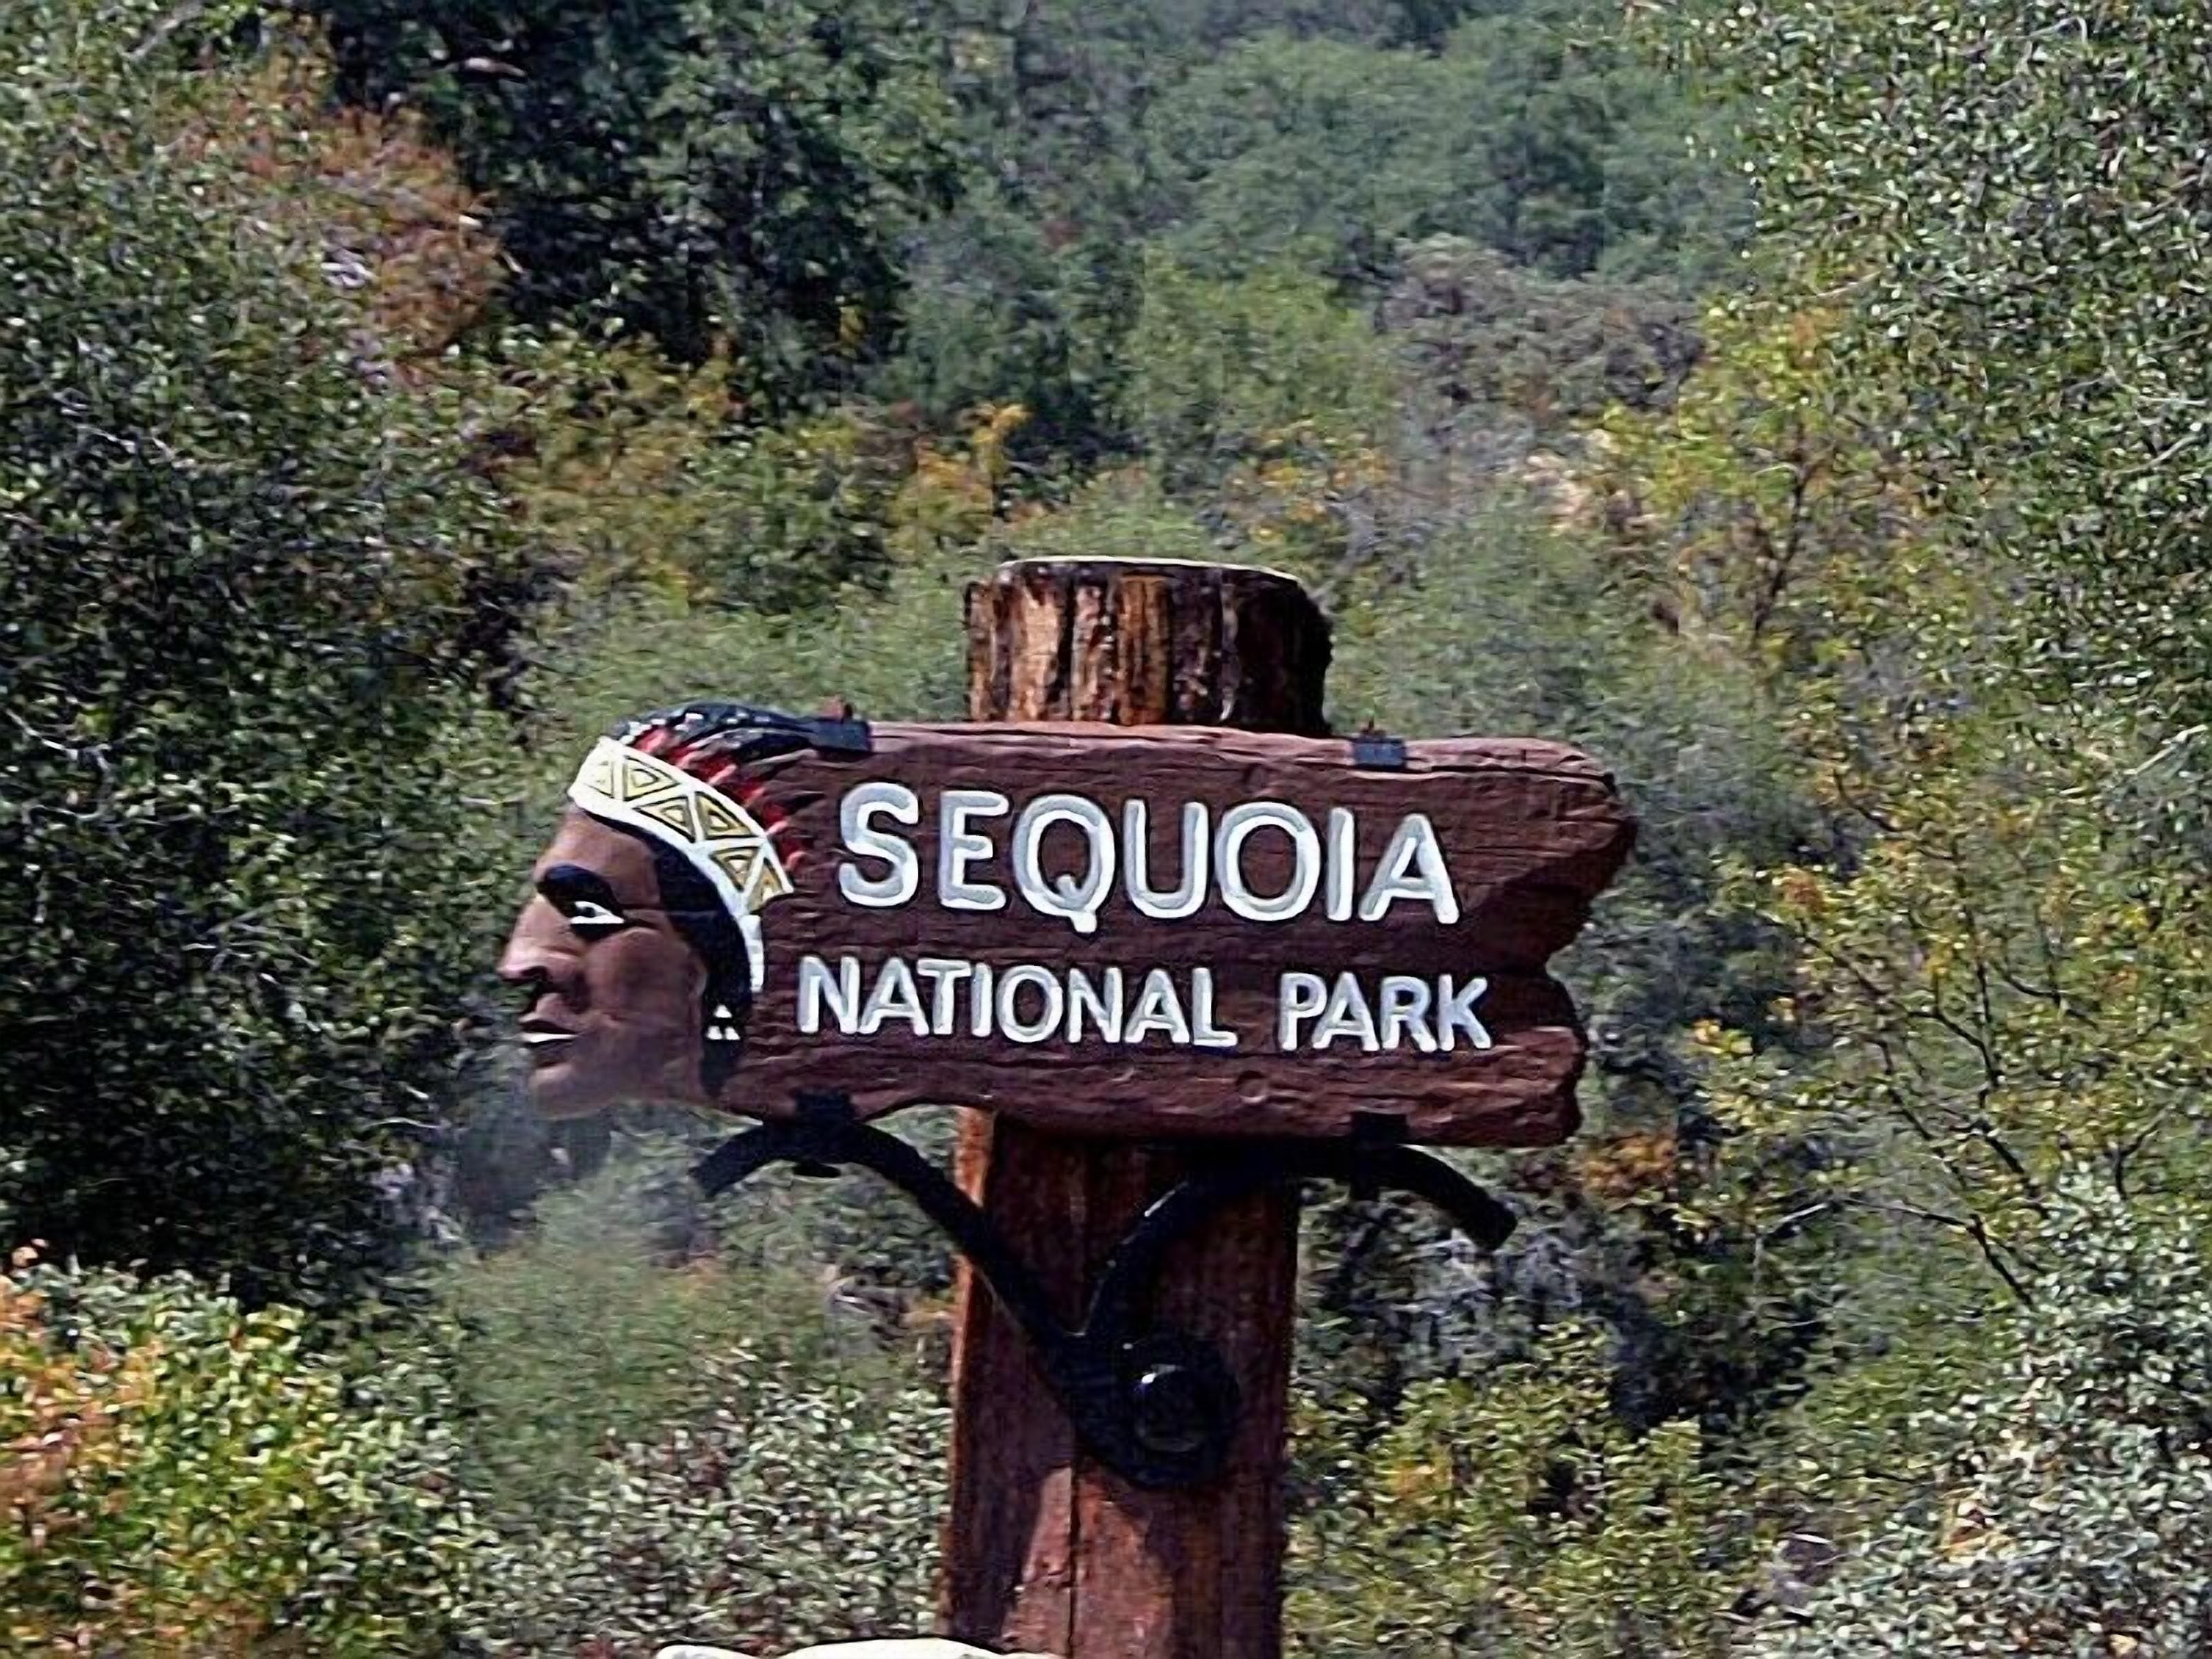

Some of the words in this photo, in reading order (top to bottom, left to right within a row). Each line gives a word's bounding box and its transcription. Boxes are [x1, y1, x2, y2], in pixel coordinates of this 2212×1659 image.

[838, 781, 1460, 933] SEQUOIA
[797, 955, 1239, 1048] NATIONAL
[1277, 971, 1492, 1053] PARK
